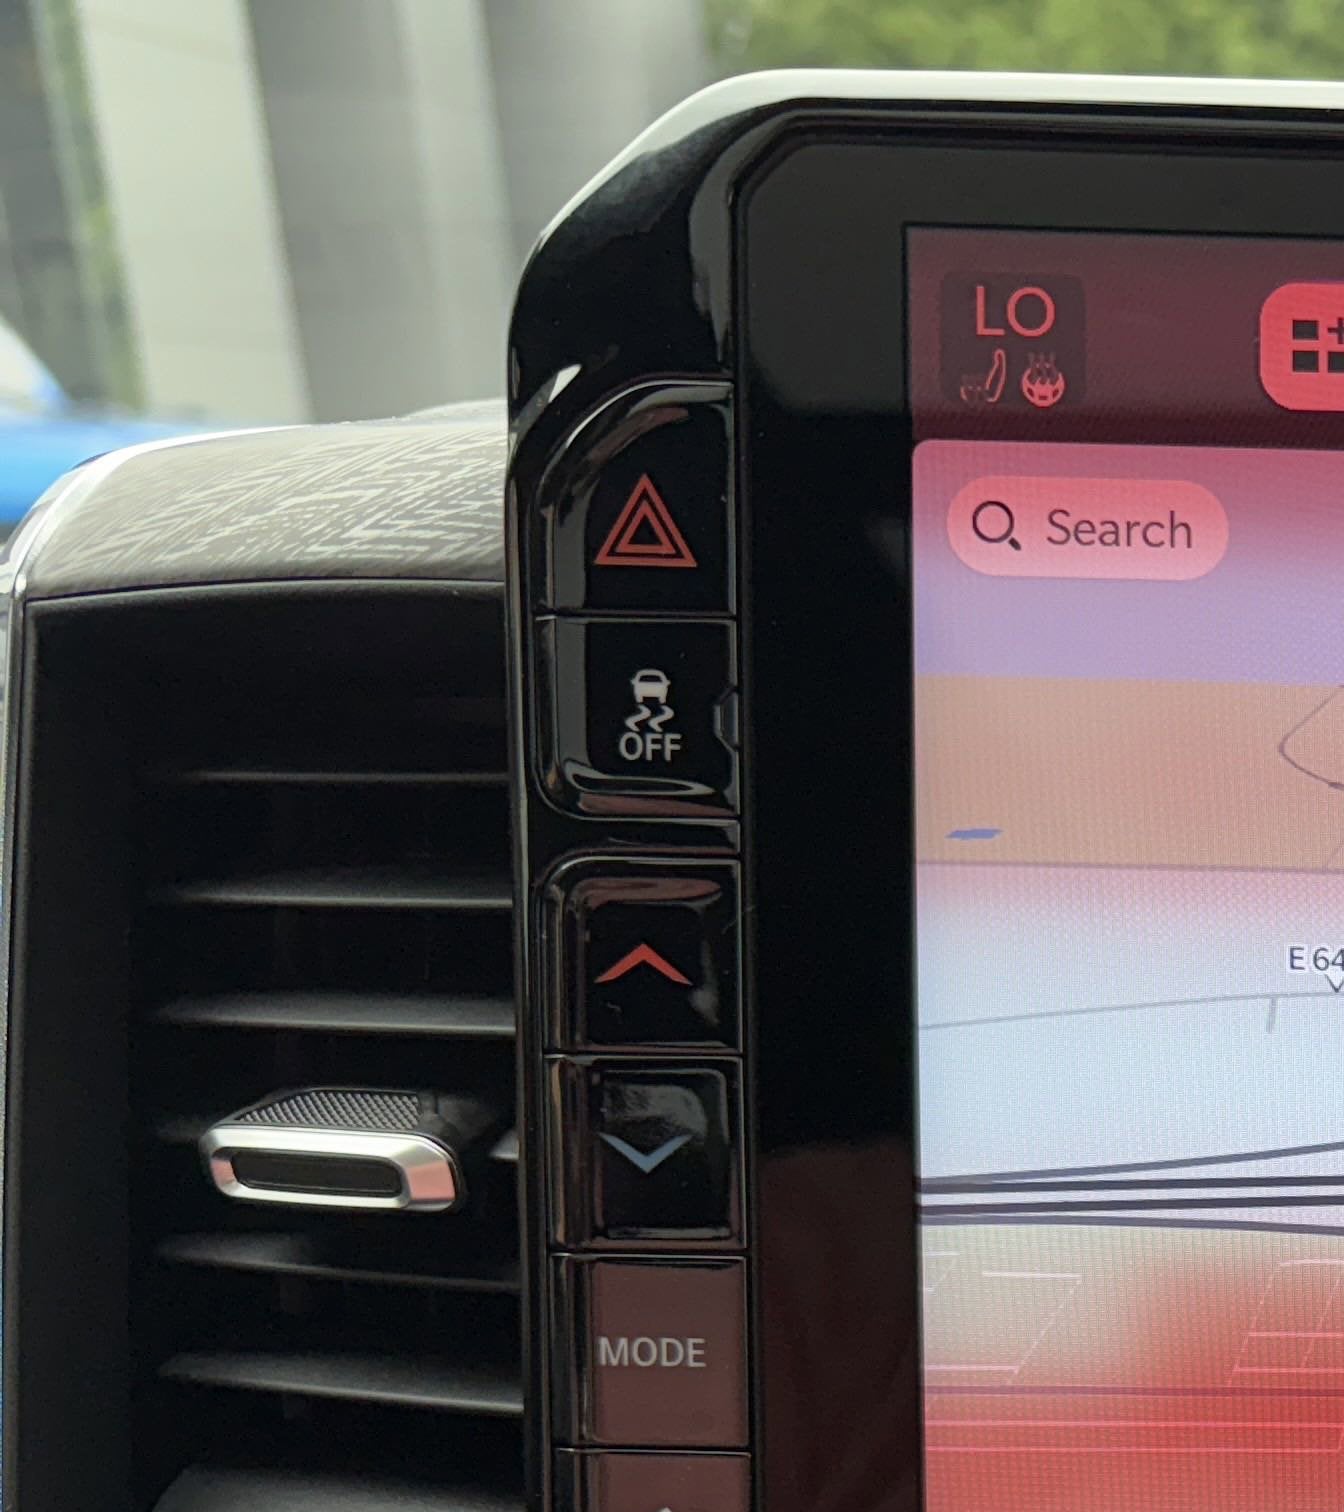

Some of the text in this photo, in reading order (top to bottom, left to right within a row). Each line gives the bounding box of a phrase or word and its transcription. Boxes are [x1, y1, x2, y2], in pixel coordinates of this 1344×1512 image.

[976, 286, 1056, 338] LO
[1046, 509, 1193, 549] Search
[618, 732, 682, 762] OFF
[1289, 947, 1305, 971] E
[600, 1337, 707, 1368] MODE
